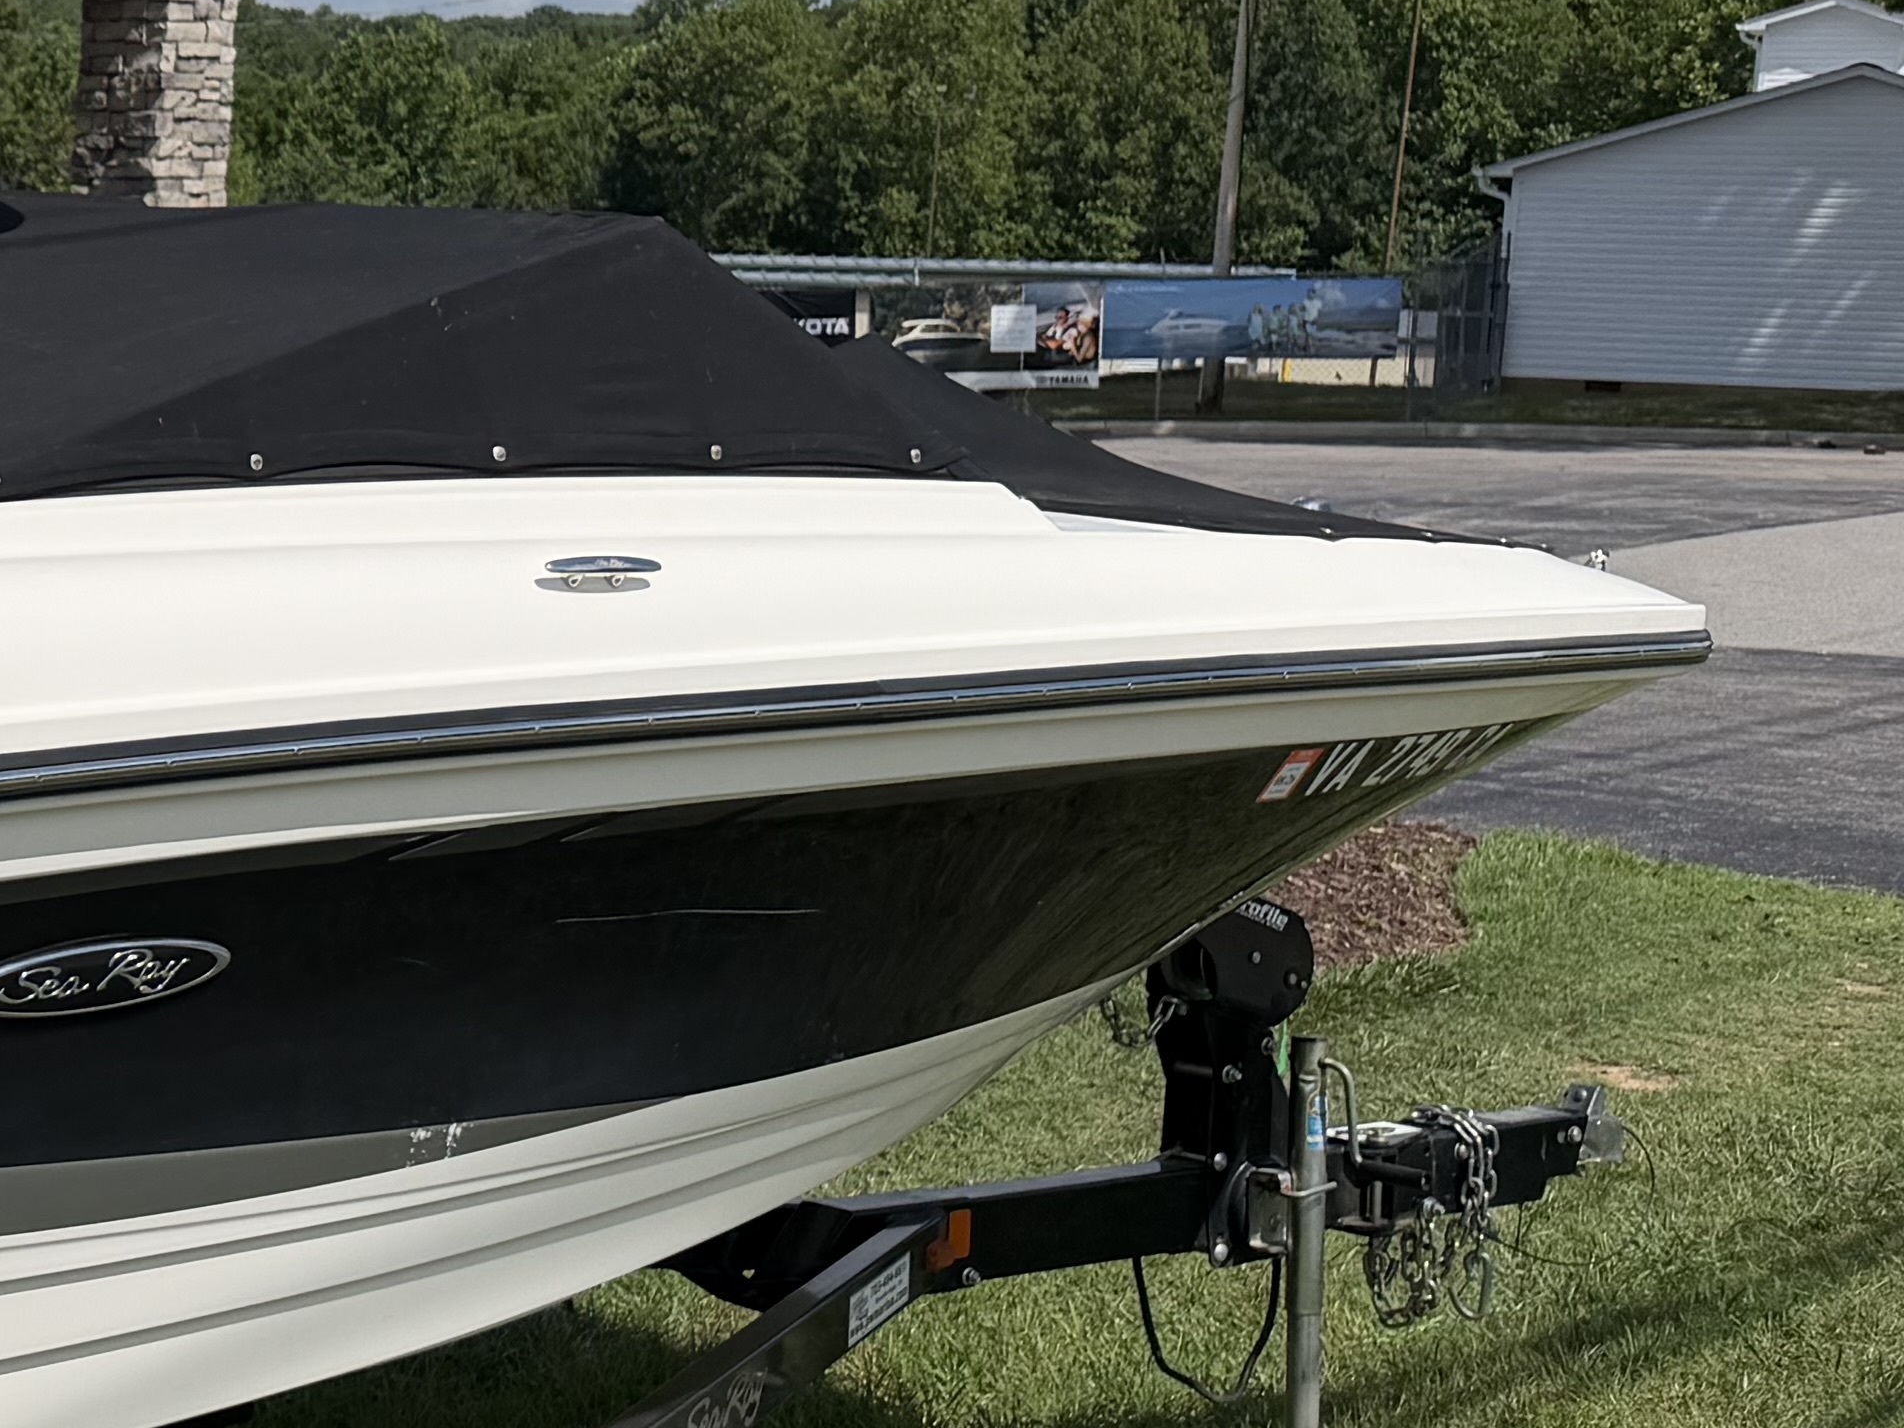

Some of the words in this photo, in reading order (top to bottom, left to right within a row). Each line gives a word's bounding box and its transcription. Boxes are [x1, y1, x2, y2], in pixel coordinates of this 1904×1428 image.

[796, 317, 850, 336] OTA
[1049, 375, 1089, 386] YAMAHA
[1304, 740, 1375, 797] VA
[1361, 729, 1472, 788] 2749
[1239, 901, 1289, 926] rofile
[95, 948, 191, 995] Ray
[722, 1366, 769, 1428] Ray
